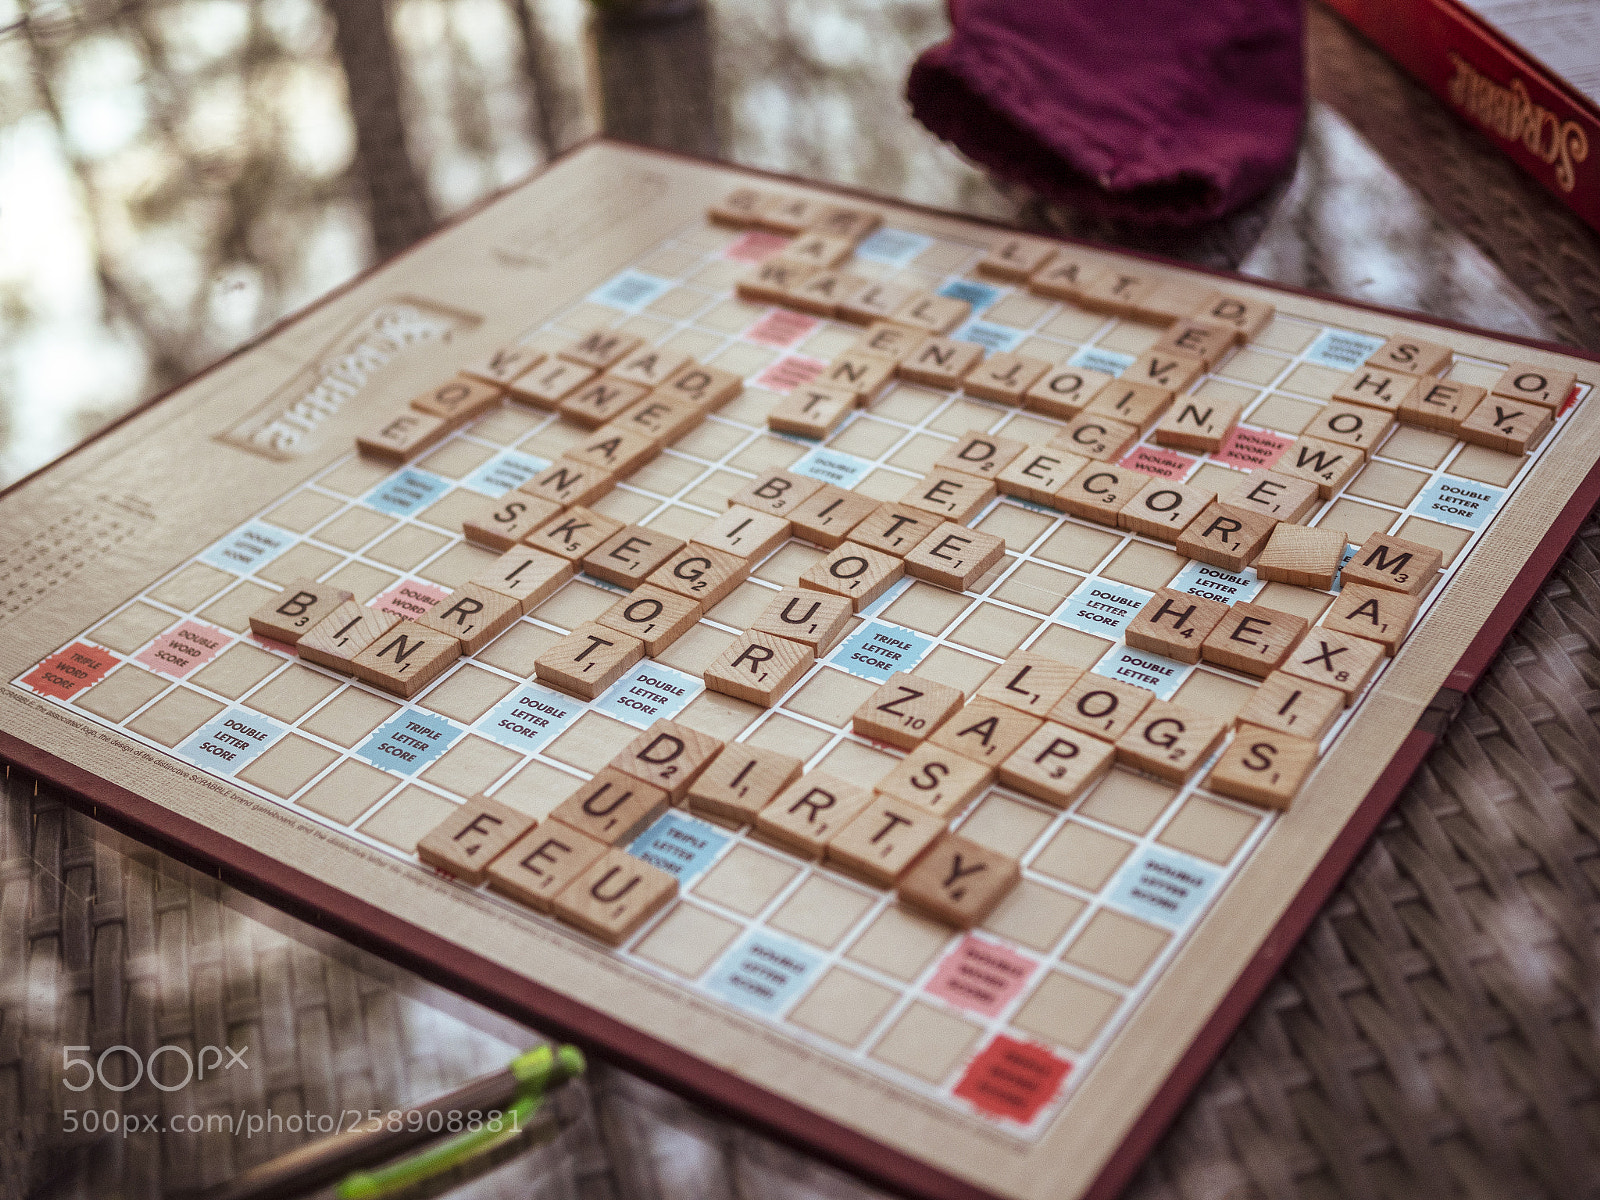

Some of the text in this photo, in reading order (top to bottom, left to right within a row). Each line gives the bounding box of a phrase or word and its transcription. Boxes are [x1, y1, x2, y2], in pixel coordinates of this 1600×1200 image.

[1233, 442, 1273, 457] WORD
[1237, 432, 1287, 450] DOUBLE
[1139, 452, 1186, 470] DOUBLE
[1227, 450, 1268, 466] SCORE
[1134, 462, 1173, 477] WORD
[1438, 494, 1479, 510] LETTER
[1441, 484, 1491, 502] DOUBLE
[1431, 502, 1474, 519] SCORE
[1198, 567, 1251, 586] DOUBLE
[1186, 587, 1231, 604] SCORE
[1194, 578, 1238, 595] LETTER
[391, 598, 426, 615] WORD
[1085, 600, 1129, 617] LETTER
[1090, 589, 1142, 609] DOUBLE
[1076, 610, 1121, 627] SCORE
[168, 640, 202, 658] WORD
[177, 630, 219, 650] DOUBLE
[872, 632, 912, 651] TRIPLE
[70, 652, 102, 670] TRIPLE
[154, 649, 190, 668] SCORE
[861, 642, 902, 661] LETTER
[56, 661, 88, 680] WORD
[850, 652, 893, 671] SCORE
[1121, 655, 1175, 676] DOUBLE
[40, 672, 76, 690] SCORE
[636, 674, 685, 696] DOUBLE
[1116, 667, 1160, 686] LETTER
[628, 686, 668, 704] LETTER
[518, 696, 567, 719] DOUBLE
[617, 696, 658, 715] SCORE
[510, 708, 550, 728] LETTER
[223, 720, 268, 742] DOUBLE
[405, 721, 442, 740] TRIPLE
[498, 720, 538, 740] SCORE
[213, 730, 250, 750] LETTER
[390, 732, 430, 752] LETTER
[199, 742, 236, 762] SCORE
[378, 742, 416, 762] SCORE
[110, 740, 134, 752] design
[154, 760, 190, 778] distinctive
[189, 774, 232, 797] SCRABBLE
[230, 792, 252, 806] brand
